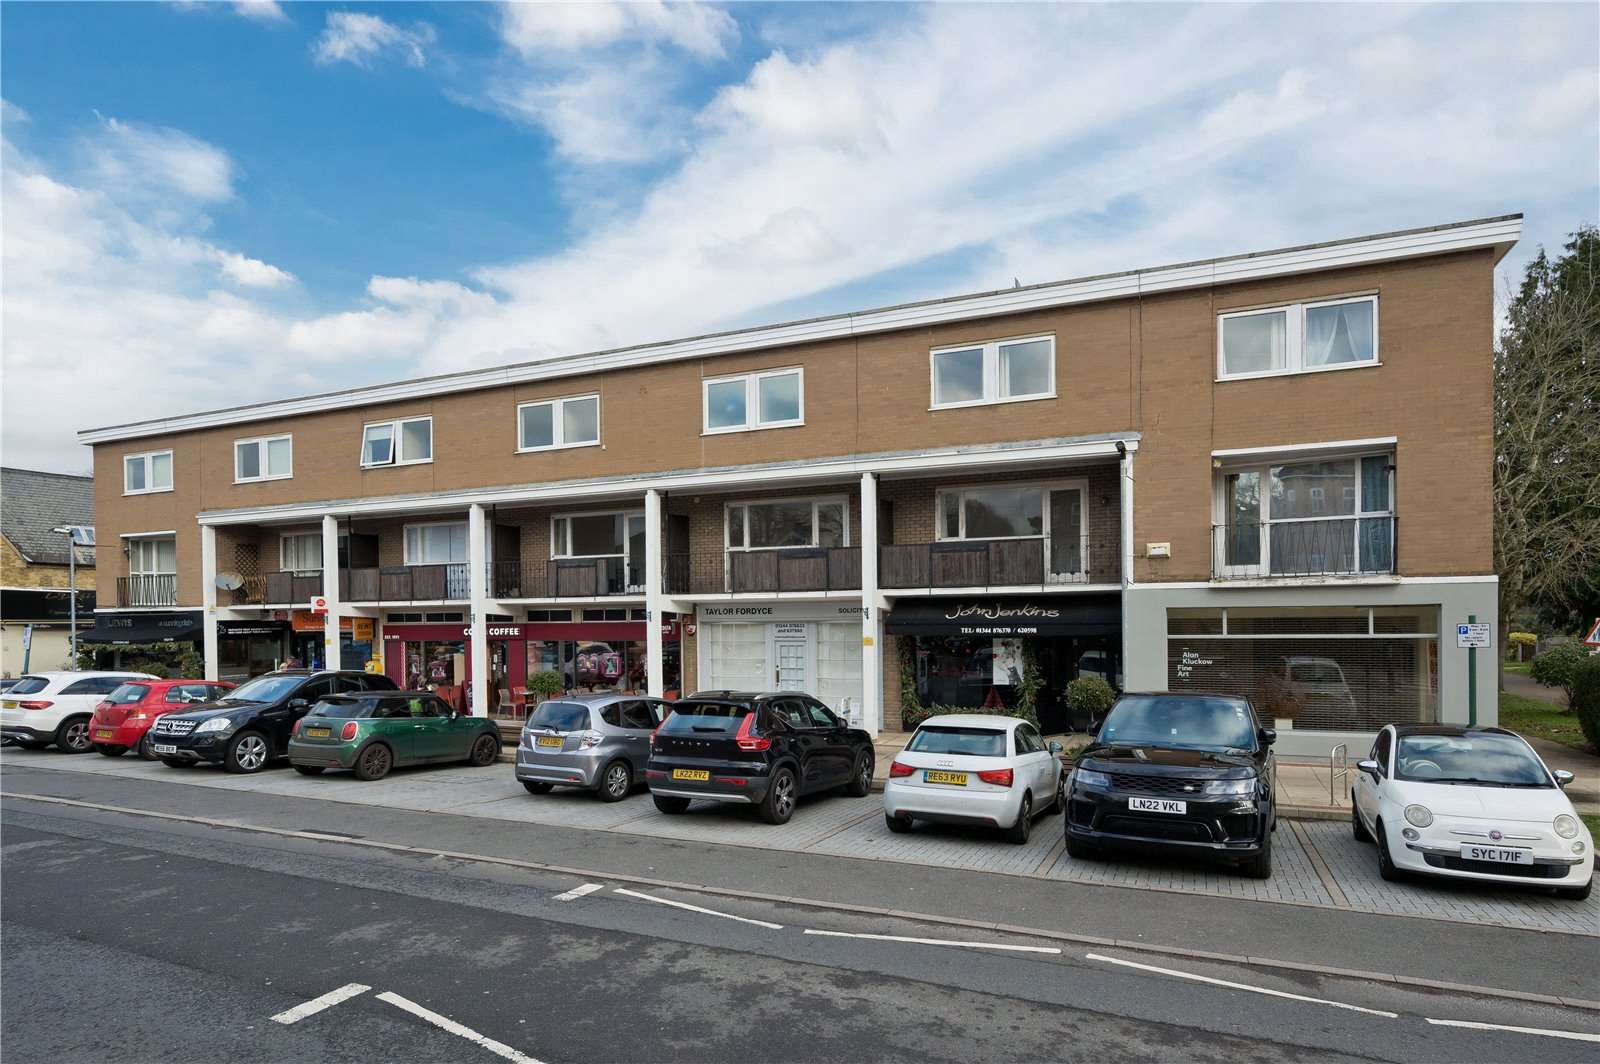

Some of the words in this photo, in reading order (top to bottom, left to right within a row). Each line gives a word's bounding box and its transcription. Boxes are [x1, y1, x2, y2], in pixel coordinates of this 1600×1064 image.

[736, 607, 773, 615] FORDYCE
[929, 772, 949, 781] RE63
[951, 774, 967, 783] RYU
[1133, 800, 1160, 810] LN22
[1162, 802, 1182, 812] VKL
[1472, 849, 1496, 860] SYC
